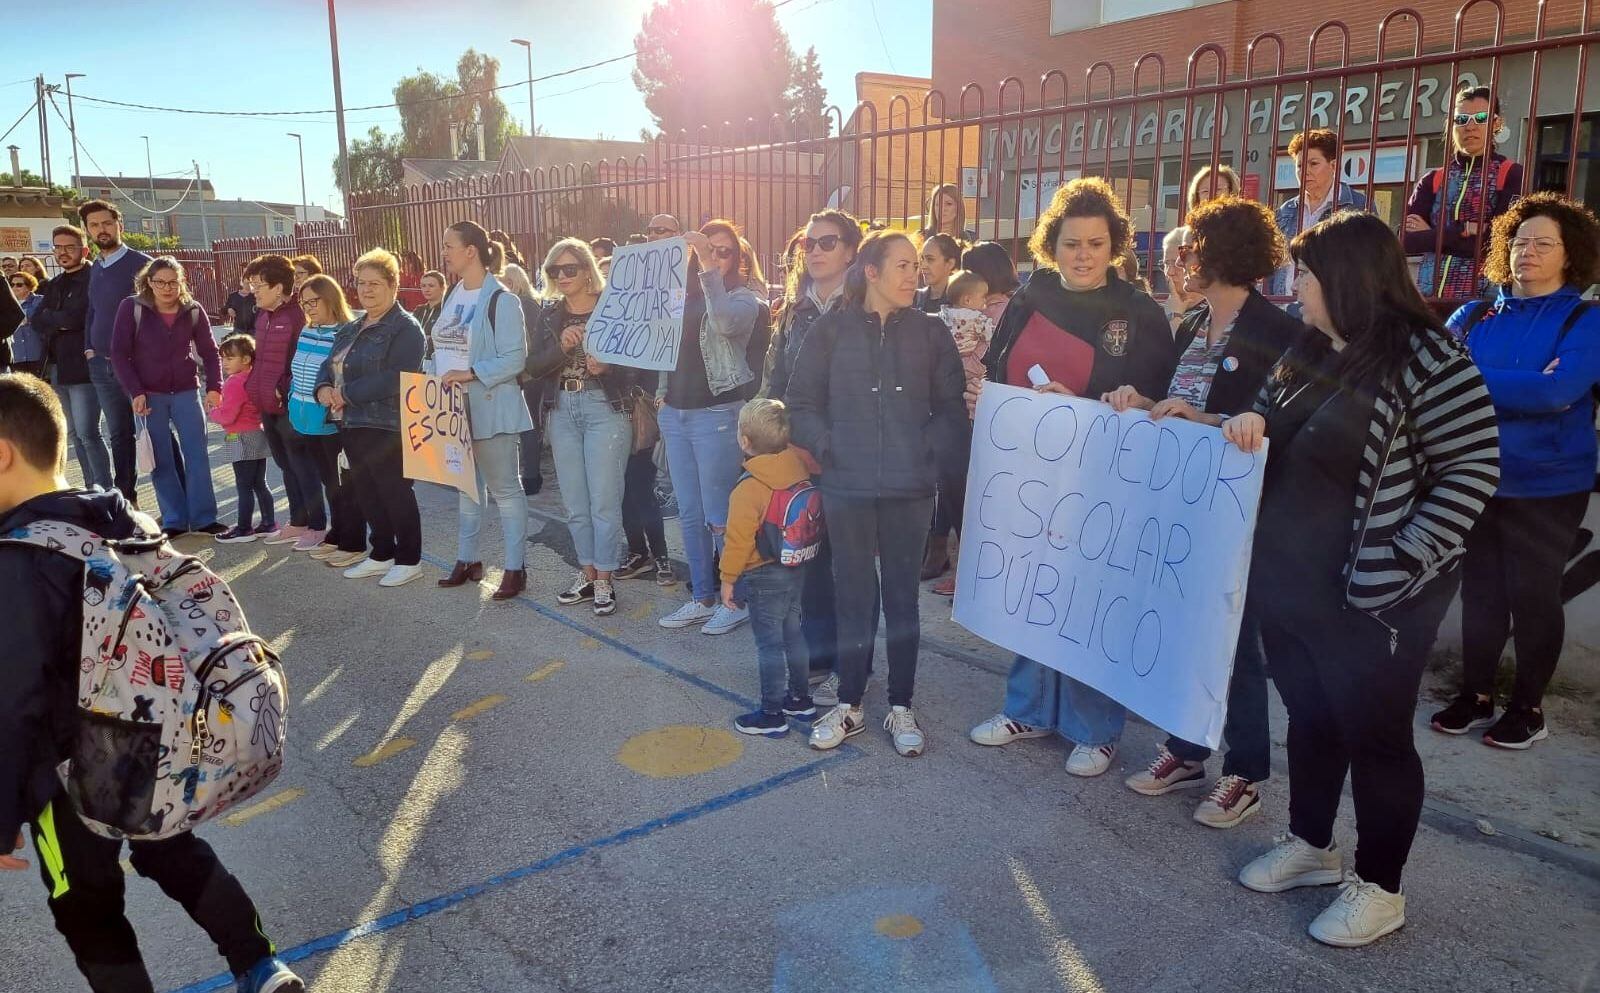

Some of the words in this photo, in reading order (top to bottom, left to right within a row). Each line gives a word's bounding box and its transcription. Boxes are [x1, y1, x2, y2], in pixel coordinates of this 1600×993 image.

[988, 104, 1229, 161] INMOBILIARIA
[601, 289, 672, 322] ESCOLAR
[611, 245, 683, 291] COMEDOR
[989, 396, 1255, 523] COMEDOR
[979, 471, 1192, 599] ESCOLAR
[971, 541, 1162, 677] PÚBLICO
